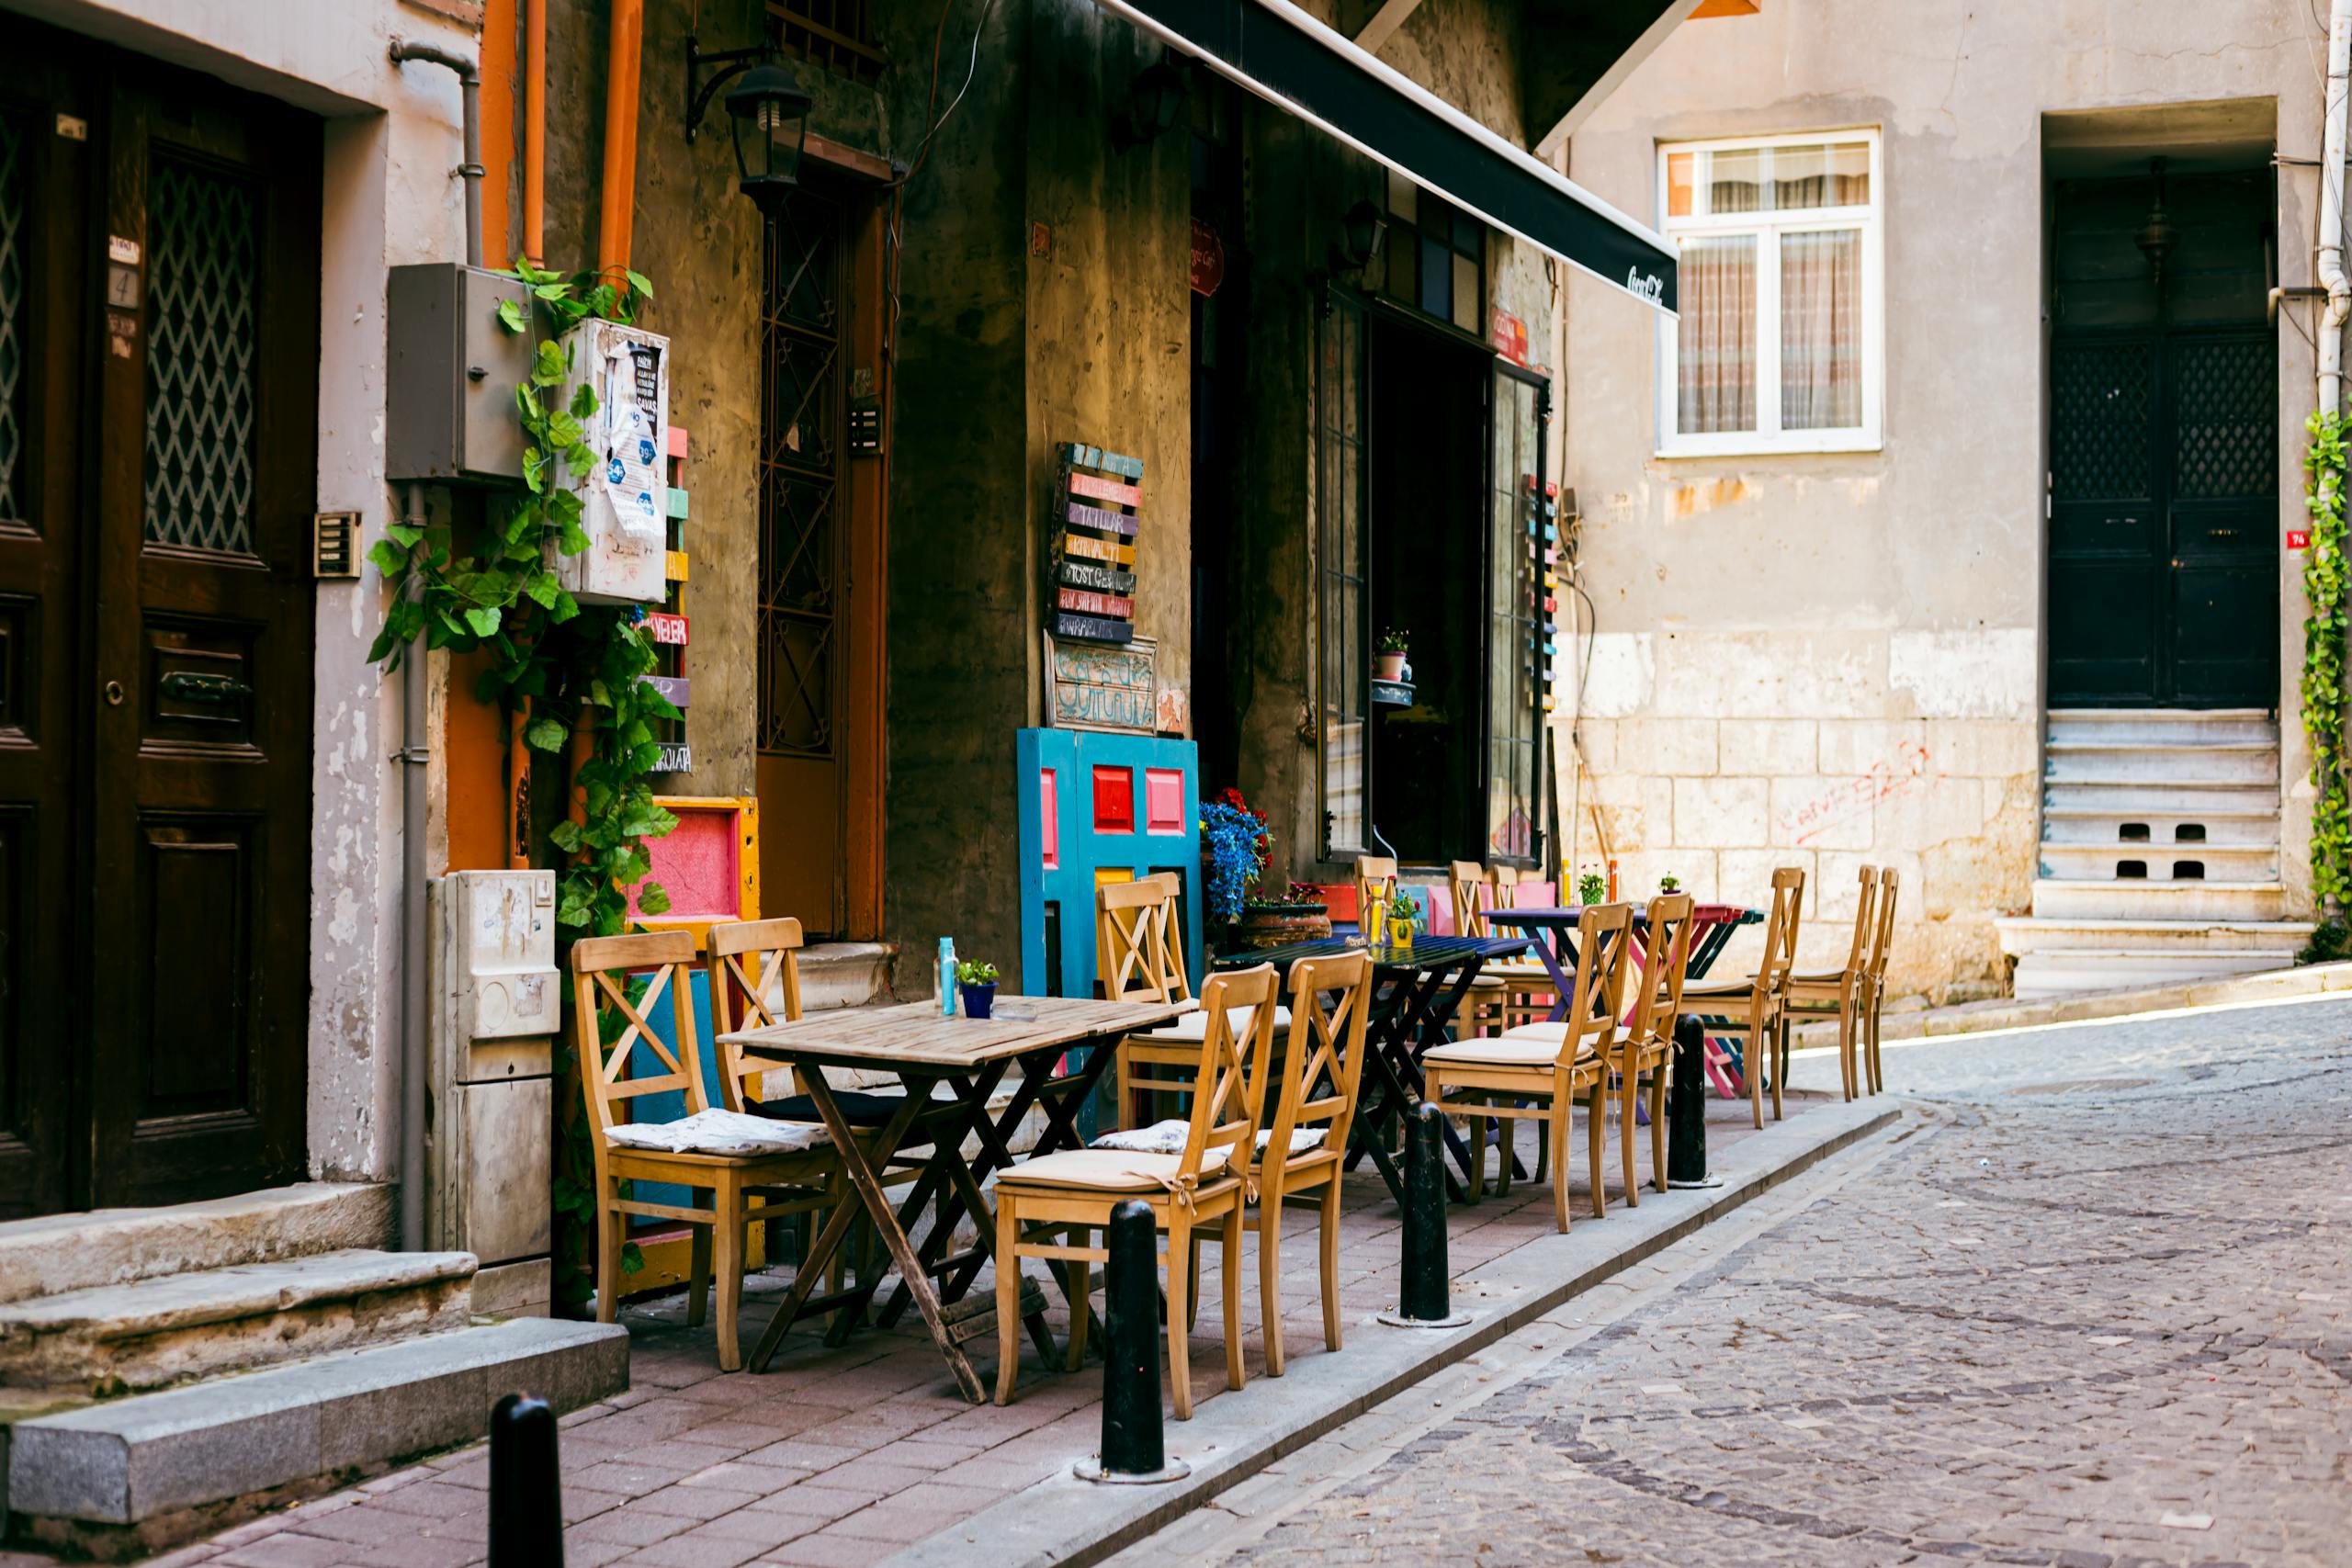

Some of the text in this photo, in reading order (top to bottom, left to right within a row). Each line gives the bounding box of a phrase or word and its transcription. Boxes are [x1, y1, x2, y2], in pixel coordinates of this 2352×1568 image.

[117, 273, 129, 300] 4
[2292, 534, 2305, 545] 74
[1069, 564, 1093, 586] TOST
